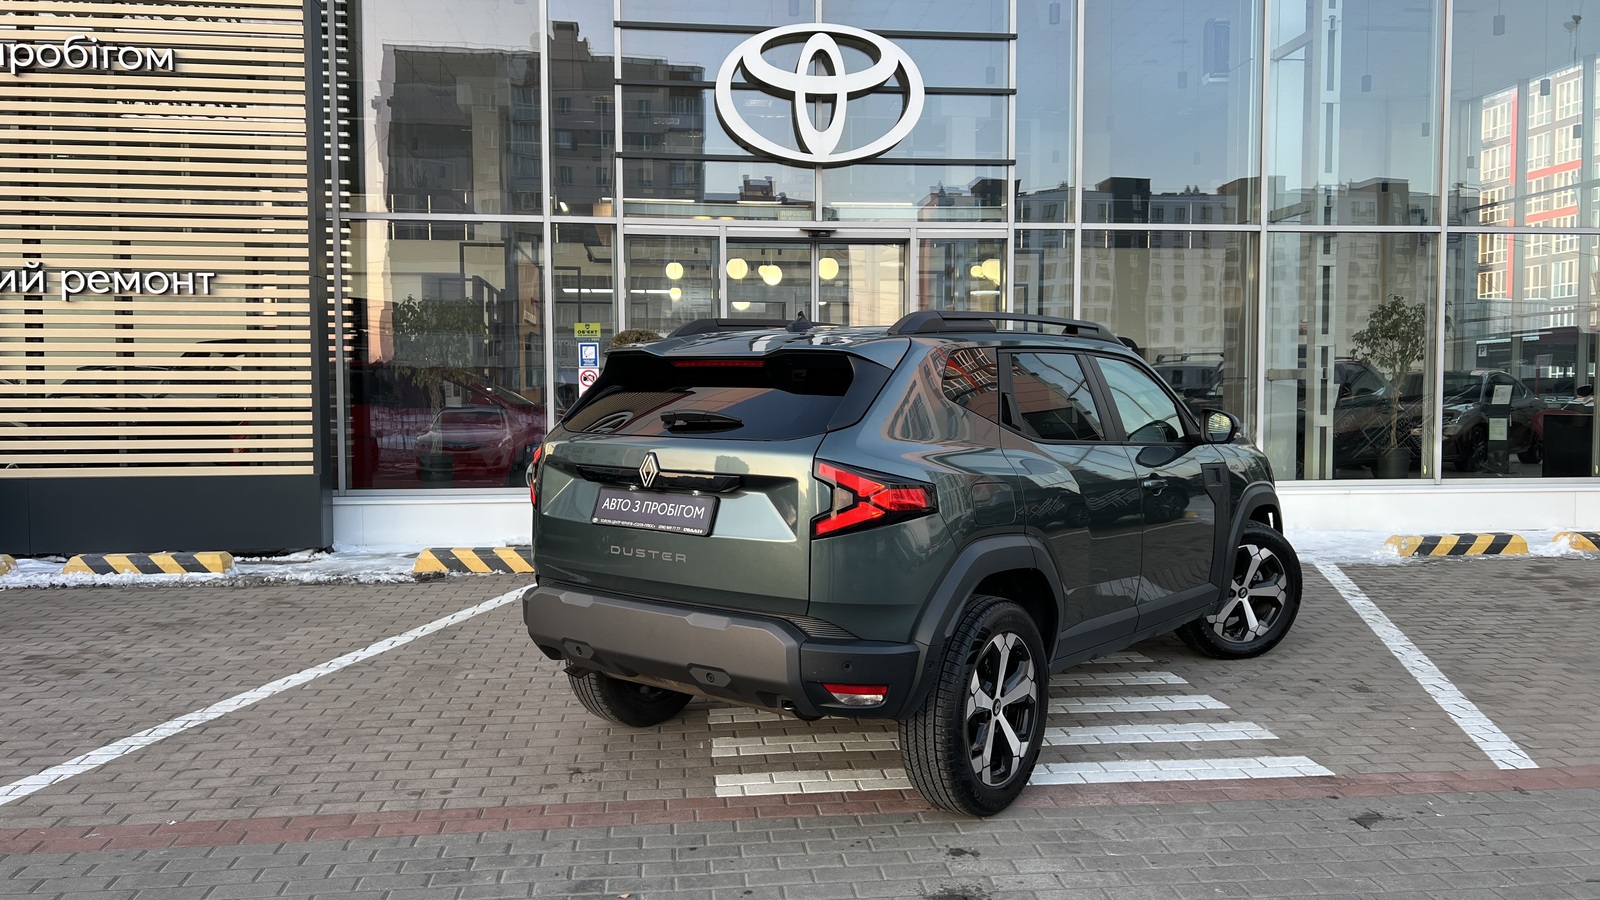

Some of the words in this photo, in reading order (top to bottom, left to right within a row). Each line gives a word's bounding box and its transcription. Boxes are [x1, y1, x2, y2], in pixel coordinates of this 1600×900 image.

[0, 35, 175, 74] робігом
[61, 269, 215, 301] ремонт
[602, 497, 631, 512] АВТО
[642, 502, 705, 519] ПРОБІГОМ
[610, 545, 687, 563] DUSTER
